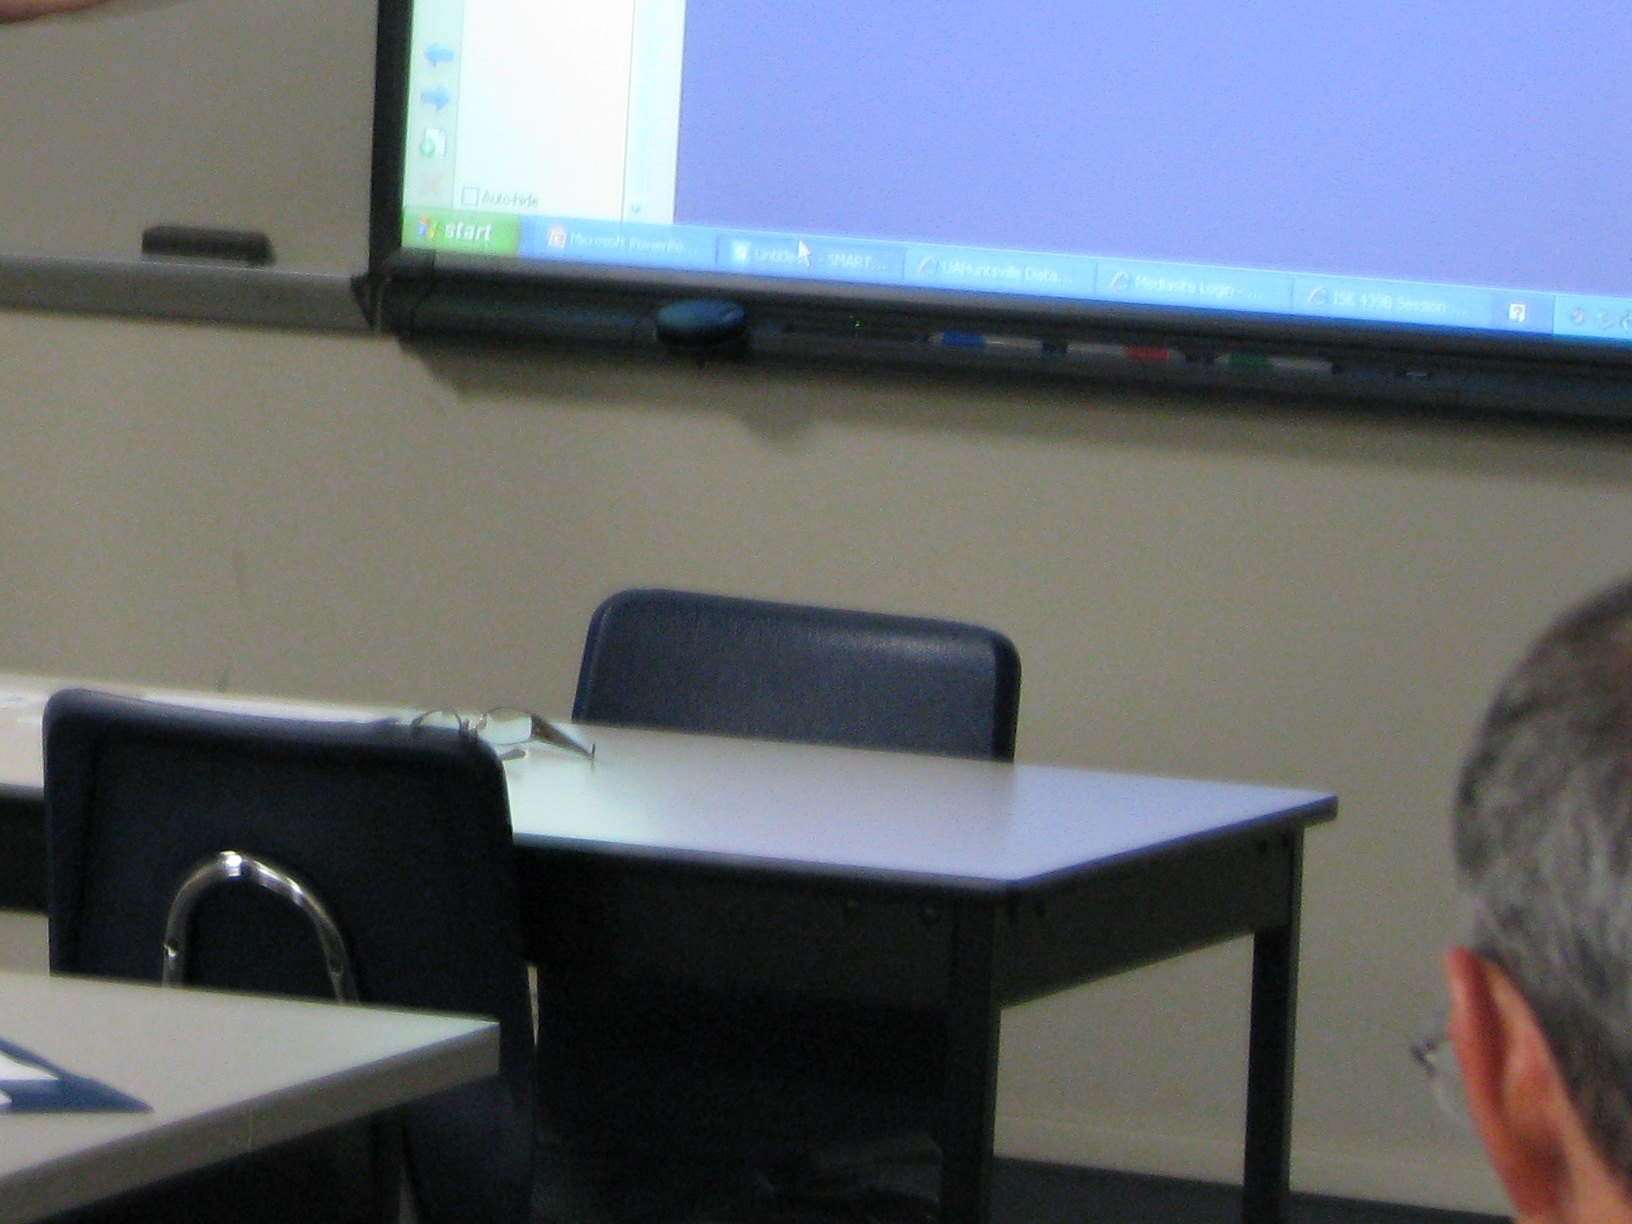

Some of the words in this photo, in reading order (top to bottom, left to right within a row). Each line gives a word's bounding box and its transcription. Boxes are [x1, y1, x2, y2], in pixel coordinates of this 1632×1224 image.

[444, 221, 493, 243] start
[570, 231, 627, 250] Microsoft
[1199, 280, 1236, 299] Login
